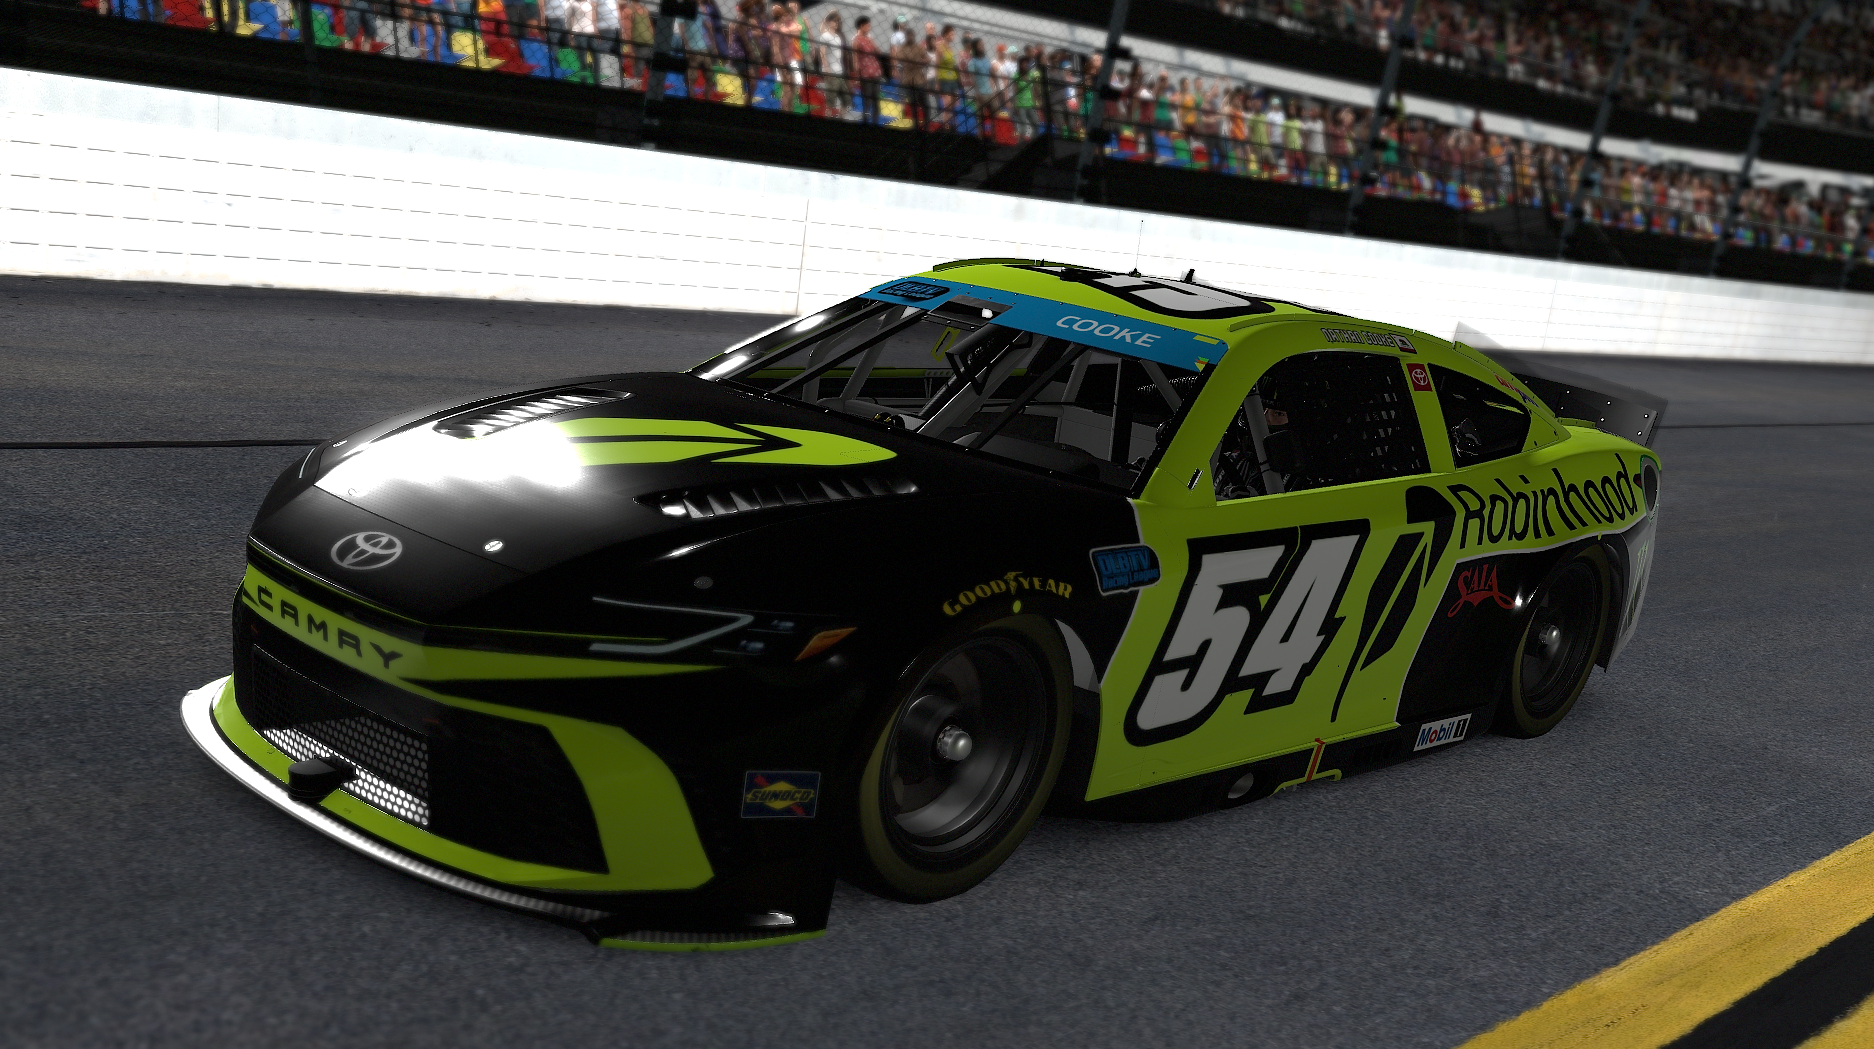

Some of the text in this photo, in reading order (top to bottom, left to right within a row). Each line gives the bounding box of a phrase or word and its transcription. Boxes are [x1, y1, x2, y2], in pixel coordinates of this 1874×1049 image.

[1056, 314, 1162, 349] COOKE
[1320, 327, 1397, 348] NATHAN COOKE
[1446, 453, 1638, 549] Robinhood
[1452, 563, 1509, 610] SAIA
[257, 586, 403, 670] CAMRY
[1130, 526, 1366, 739] 54
[1417, 718, 1468, 747] Mobil 1
[749, 789, 813, 802] SUNOCO
